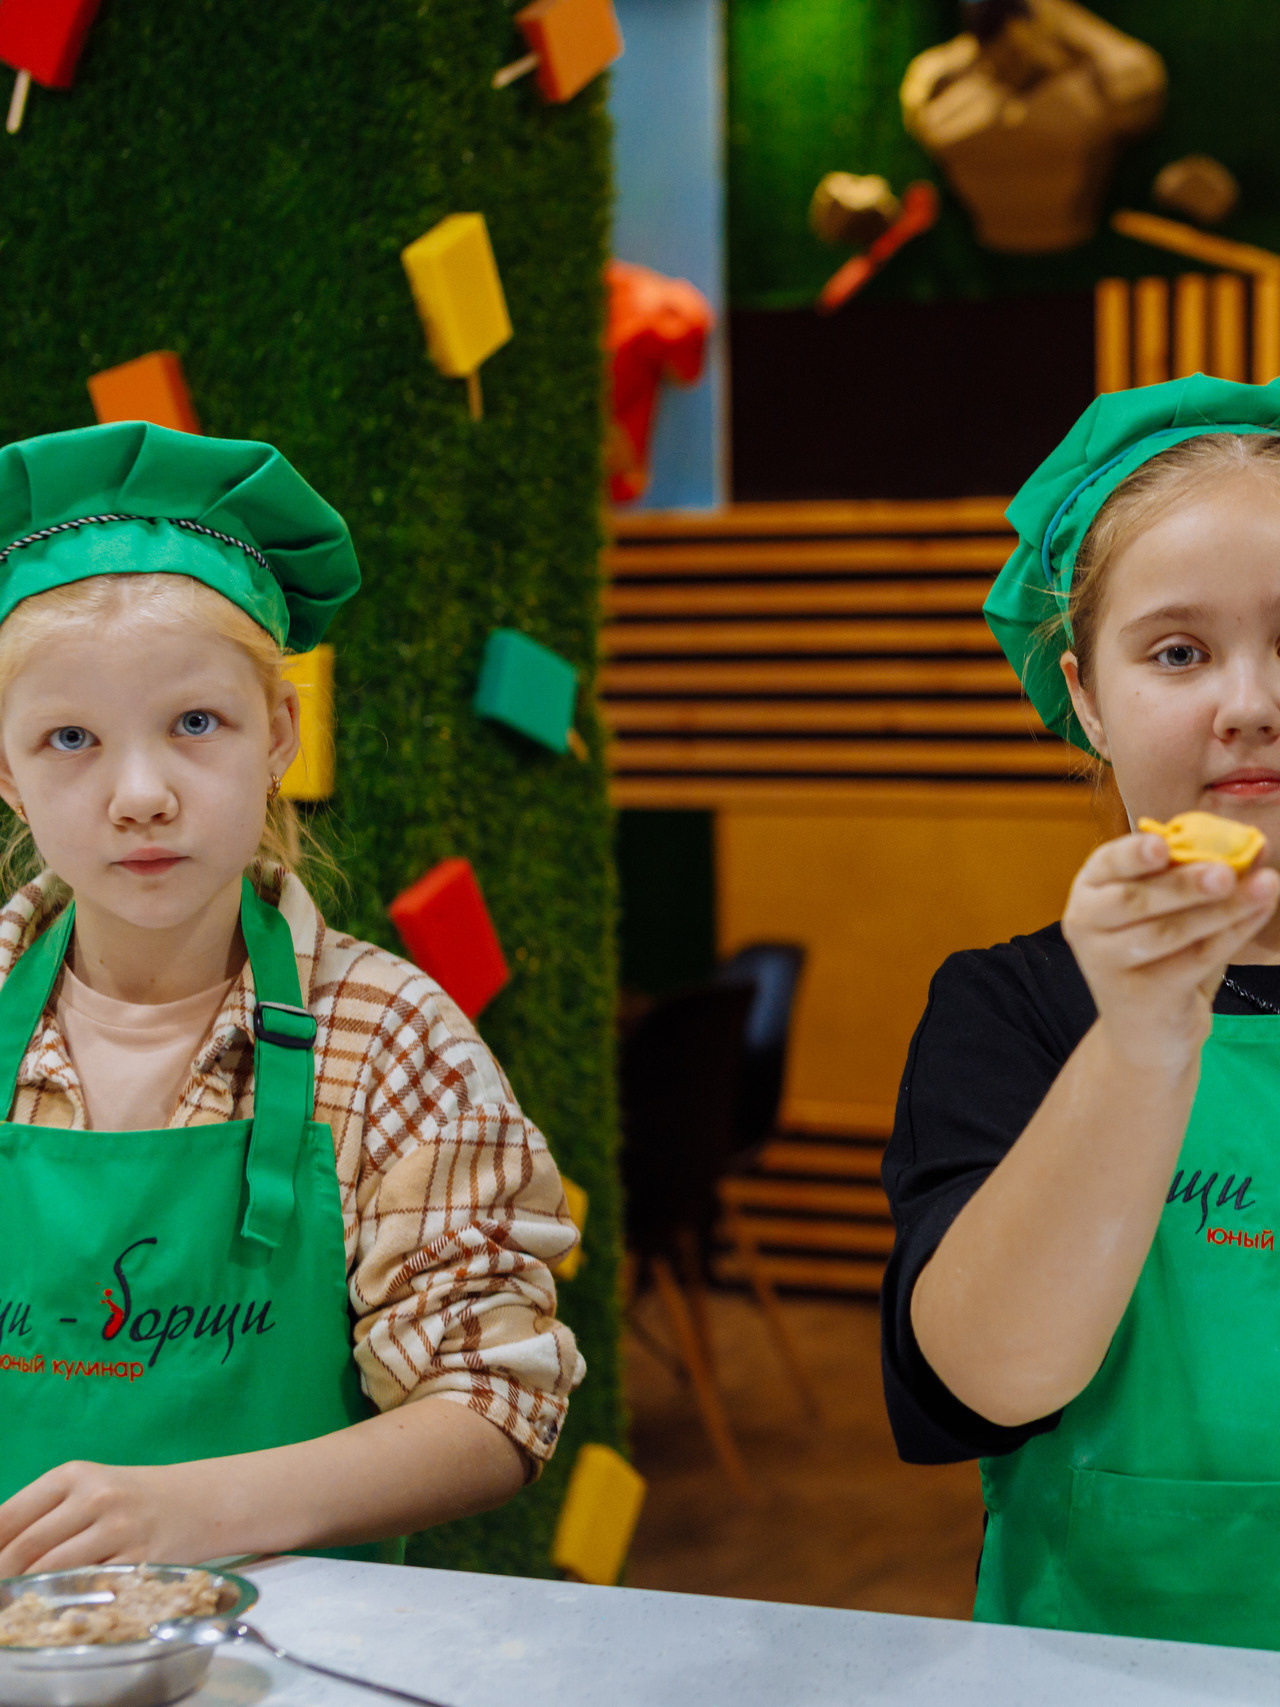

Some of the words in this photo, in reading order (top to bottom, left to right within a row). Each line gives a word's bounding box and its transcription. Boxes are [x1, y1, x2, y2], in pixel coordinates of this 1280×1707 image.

[1206, 1227, 1275, 1252] юный
[102, 1237, 275, 1368] борщи
[52, 1359, 145, 1383] кулинар
